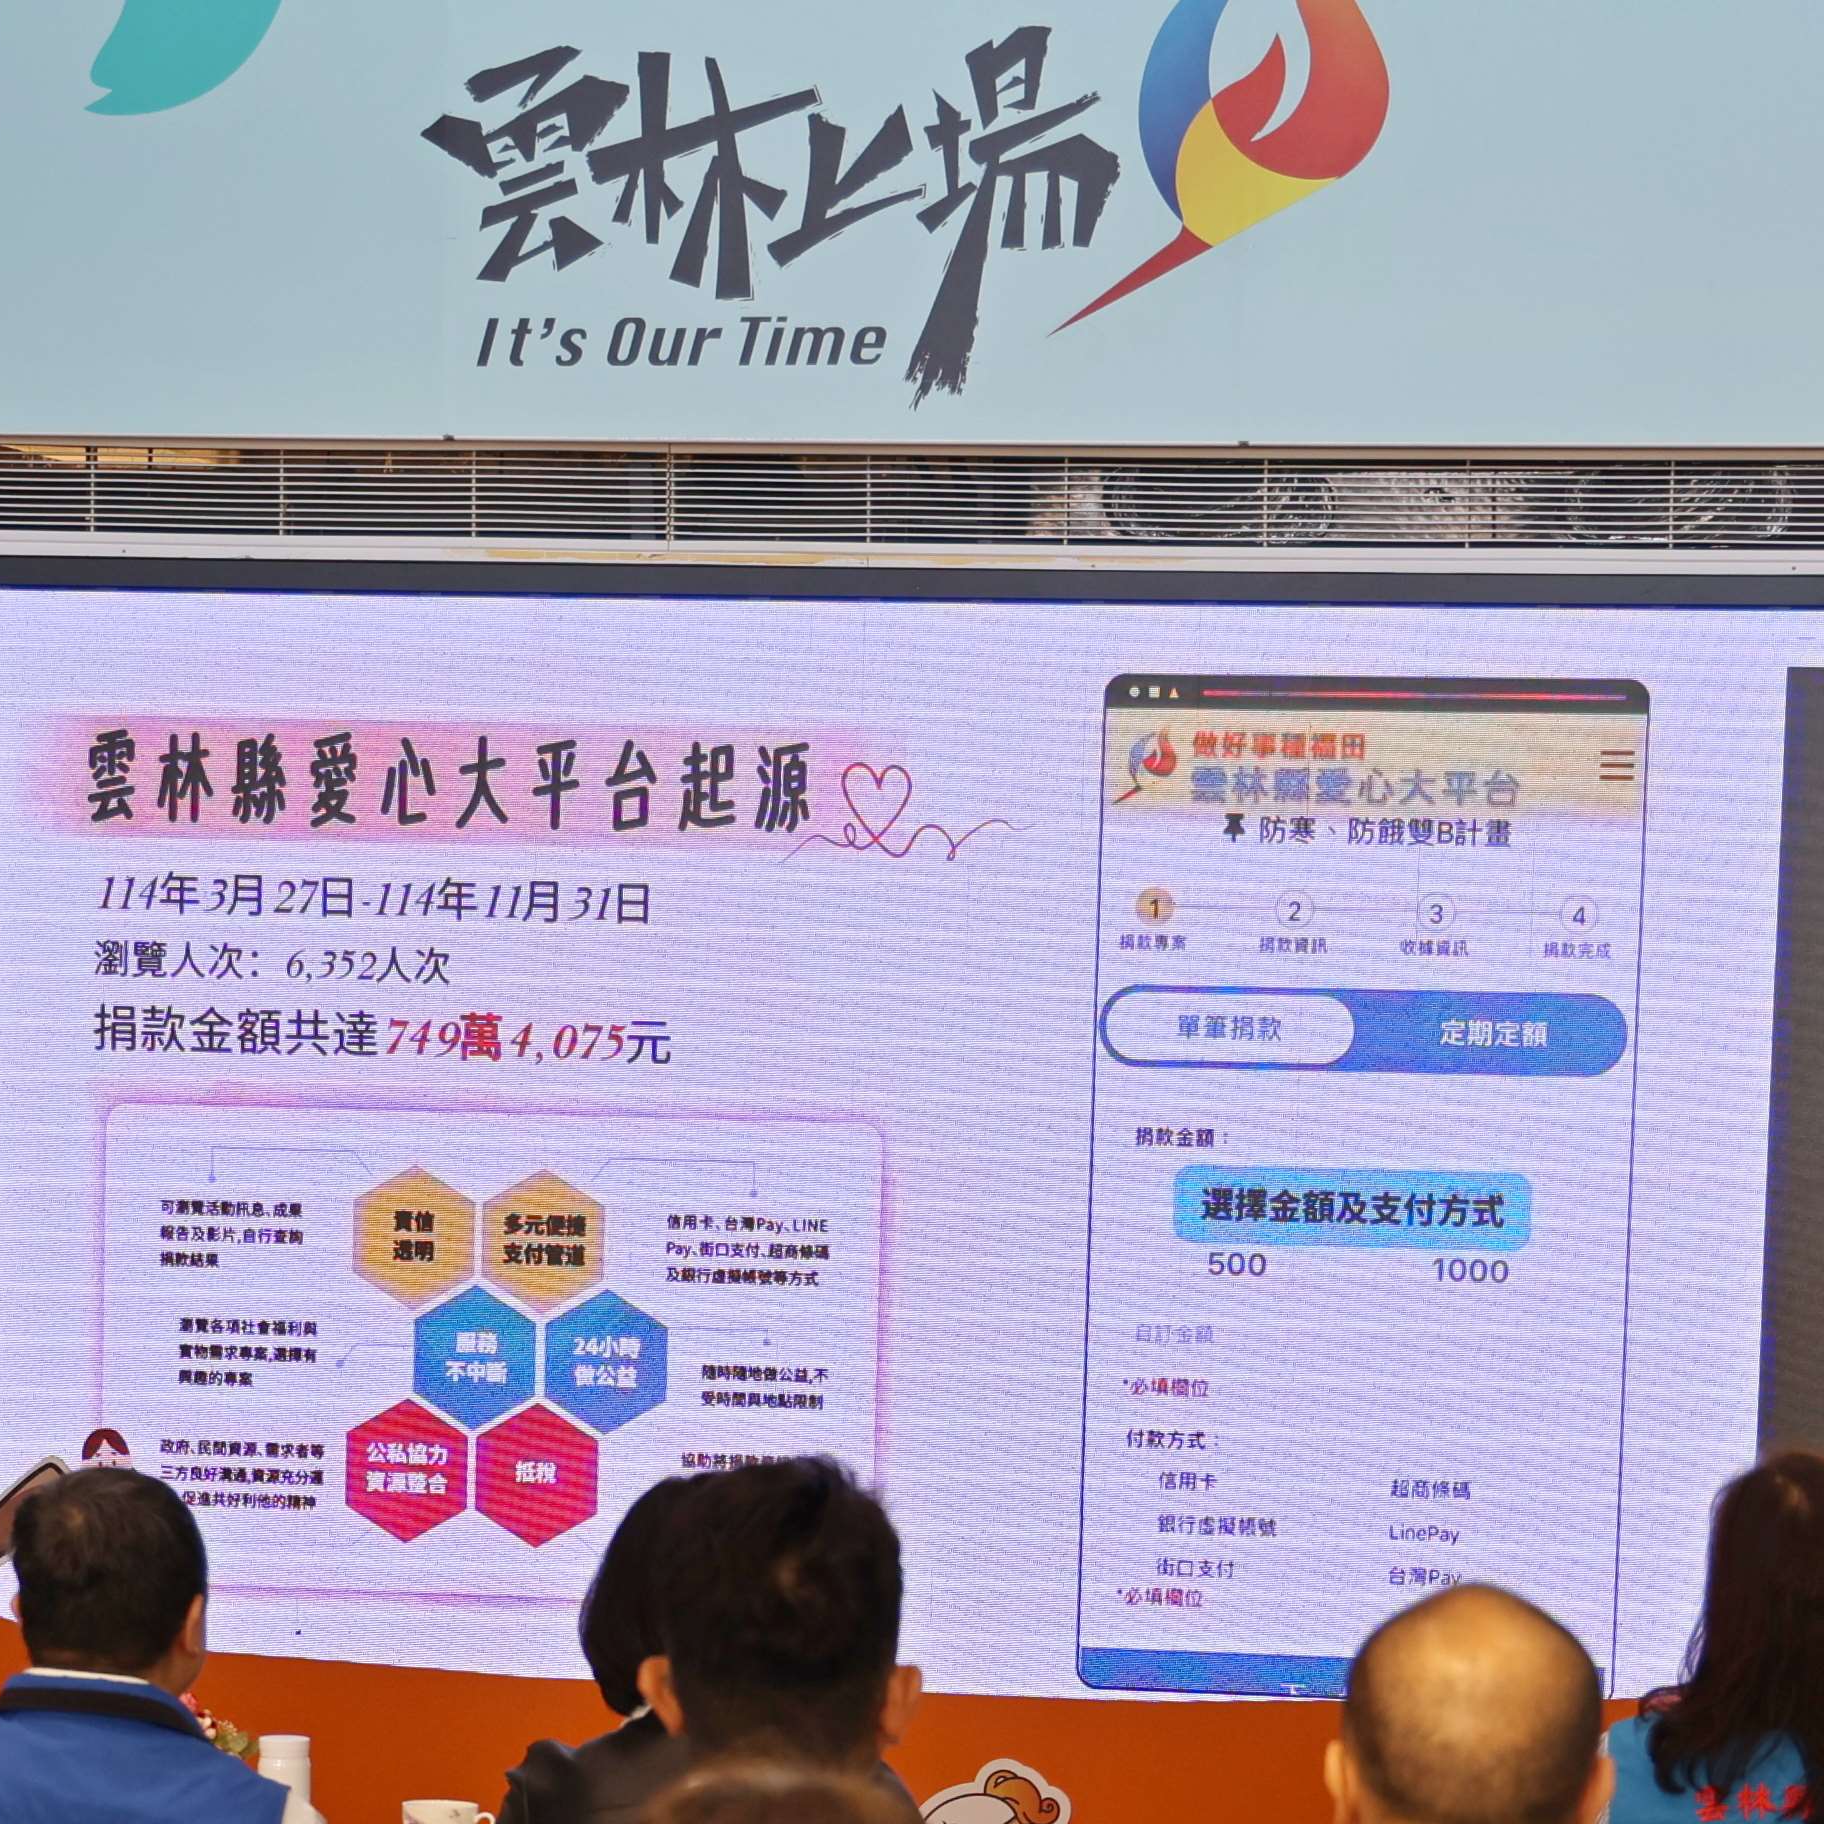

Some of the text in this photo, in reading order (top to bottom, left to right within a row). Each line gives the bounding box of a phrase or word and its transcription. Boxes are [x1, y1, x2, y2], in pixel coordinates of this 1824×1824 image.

[421, 24, 1121, 412] 雲林上場
[476, 314, 888, 368] It's Our Time
[87, 728, 812, 835] 雲林縣愛心大平台起源
[1190, 766, 1520, 807] 雲林縣愛心大平台
[1149, 897, 1161, 919] 1
[1288, 900, 1302, 922] 2
[1429, 903, 1444, 925] 3
[1572, 905, 1587, 926] 4
[1259, 936, 1329, 954] 捐款資訊
[1543, 941, 1612, 960] 捐款完成
[1177, 1014, 1283, 1043] 單筆捐款
[1440, 1018, 1549, 1049] 定期定額
[1201, 1186, 1505, 1229] 選擇金額及支付方式
[1207, 1251, 1267, 1277] 500
[1433, 1257, 1510, 1283] 1000
[573, 1363, 638, 1389] 做公益
[366, 1442, 449, 1467] 公私協力
[366, 1470, 449, 1495] 資源整合
[514, 1460, 558, 1485] 抵稅
[1158, 1471, 1218, 1491] 信用卡
[1389, 1479, 1472, 1500] 超商條碼
[1157, 1514, 1277, 1537] 銀行虛擬帳號
[1389, 1523, 1460, 1546] LinePay
[1157, 1558, 1234, 1579] 街口支付
